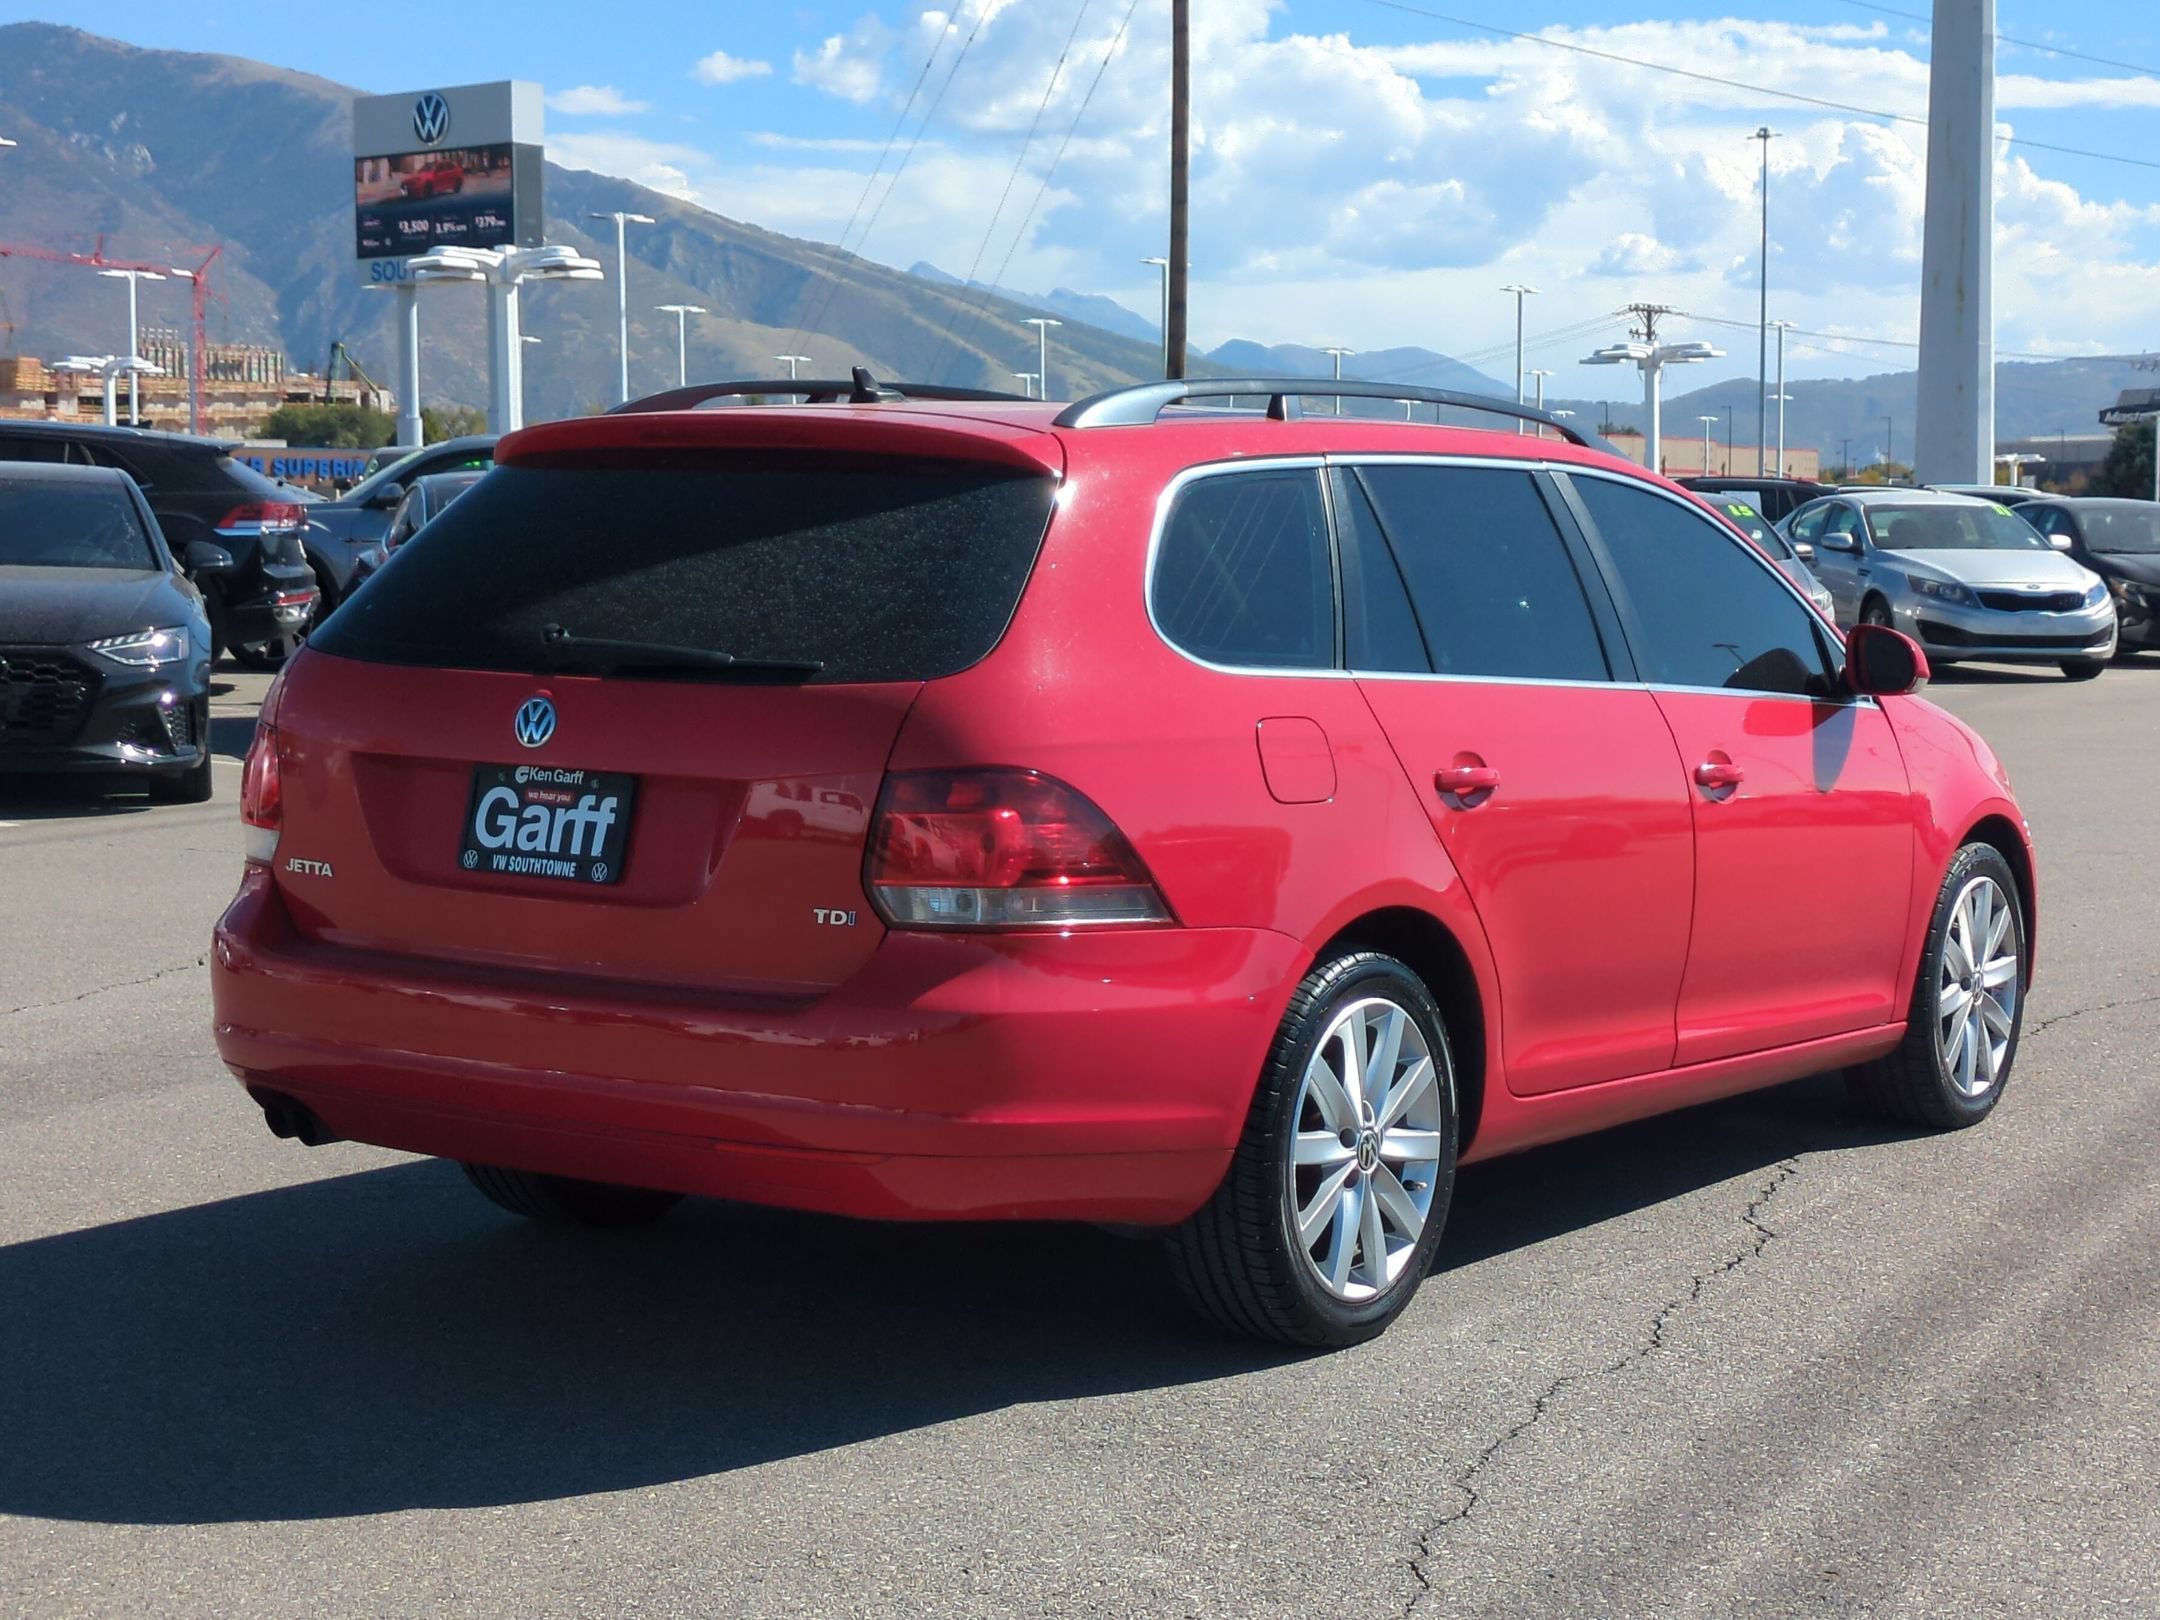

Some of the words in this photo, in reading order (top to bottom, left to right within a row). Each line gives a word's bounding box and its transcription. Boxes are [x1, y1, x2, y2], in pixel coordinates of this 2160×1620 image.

[413, 93, 448, 145] VW
[515, 697, 557, 748] VW
[530, 766, 553, 782] Ken
[554, 769, 584, 784] Garff
[557, 793, 571, 802] you
[475, 786, 617, 857] Garff
[285, 858, 333, 877] JETTA
[492, 854, 507, 871] VW
[508, 856, 577, 877] SOUTHTOWNE
[813, 908, 856, 926] TDI
